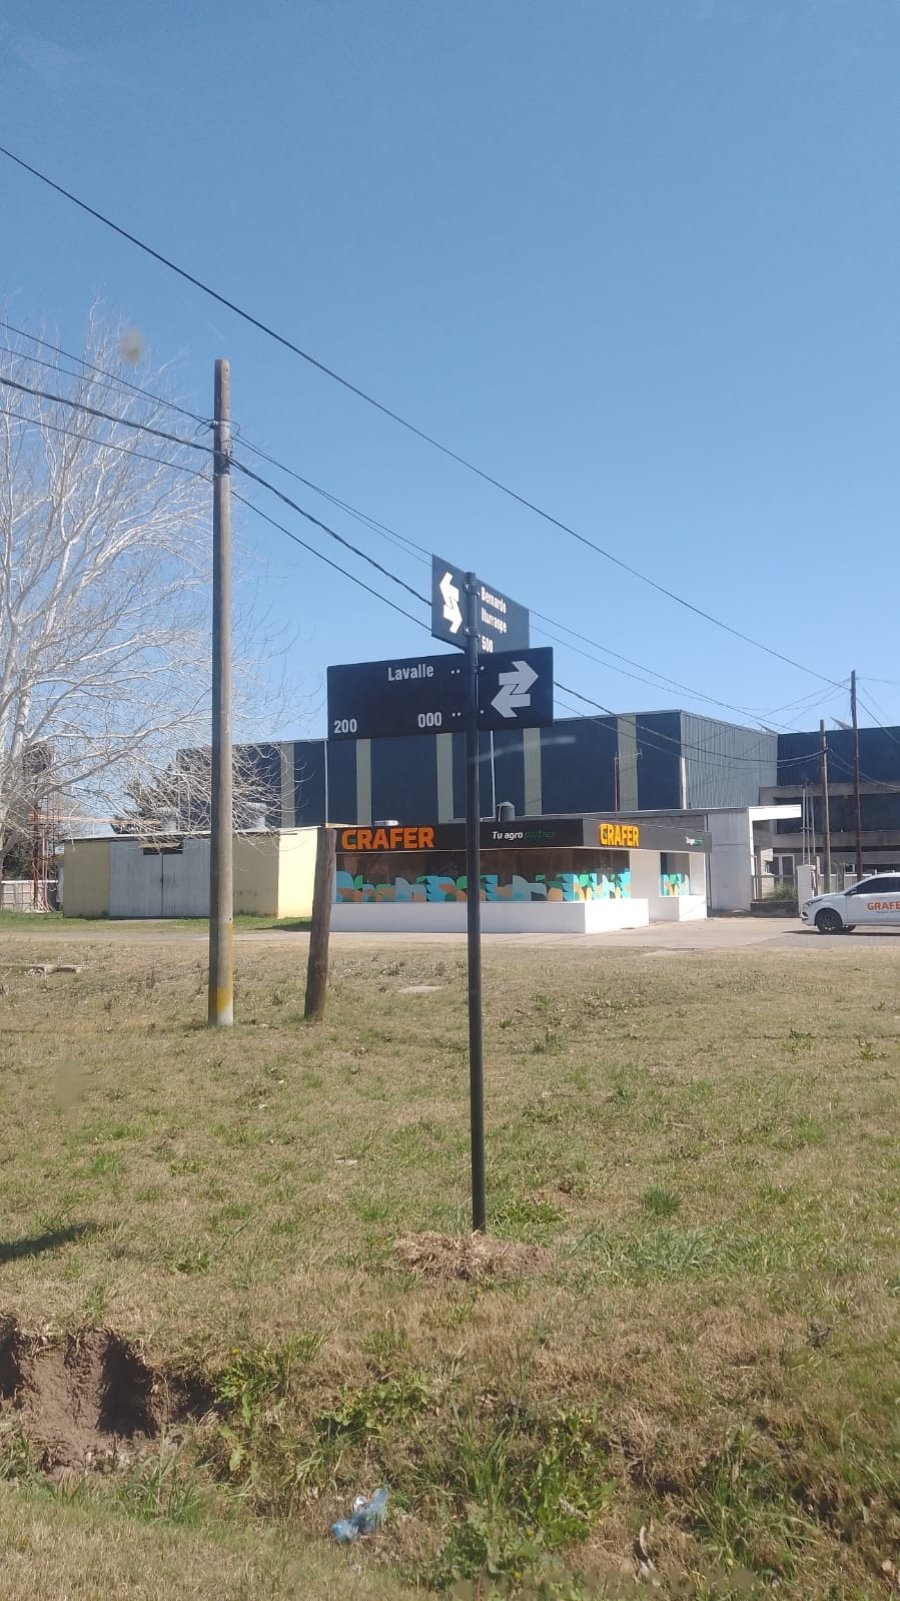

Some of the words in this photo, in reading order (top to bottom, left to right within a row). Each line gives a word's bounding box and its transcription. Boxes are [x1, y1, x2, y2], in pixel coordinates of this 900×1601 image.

[481, 635, 494, 653] 500
[387, 663, 435, 681] Lavalle
[333, 718, 358, 734] 200
[418, 712, 442, 728] 000
[341, 827, 435, 850] GRAFER
[504, 831, 524, 841] agro
[599, 823, 640, 847] GRAFER
